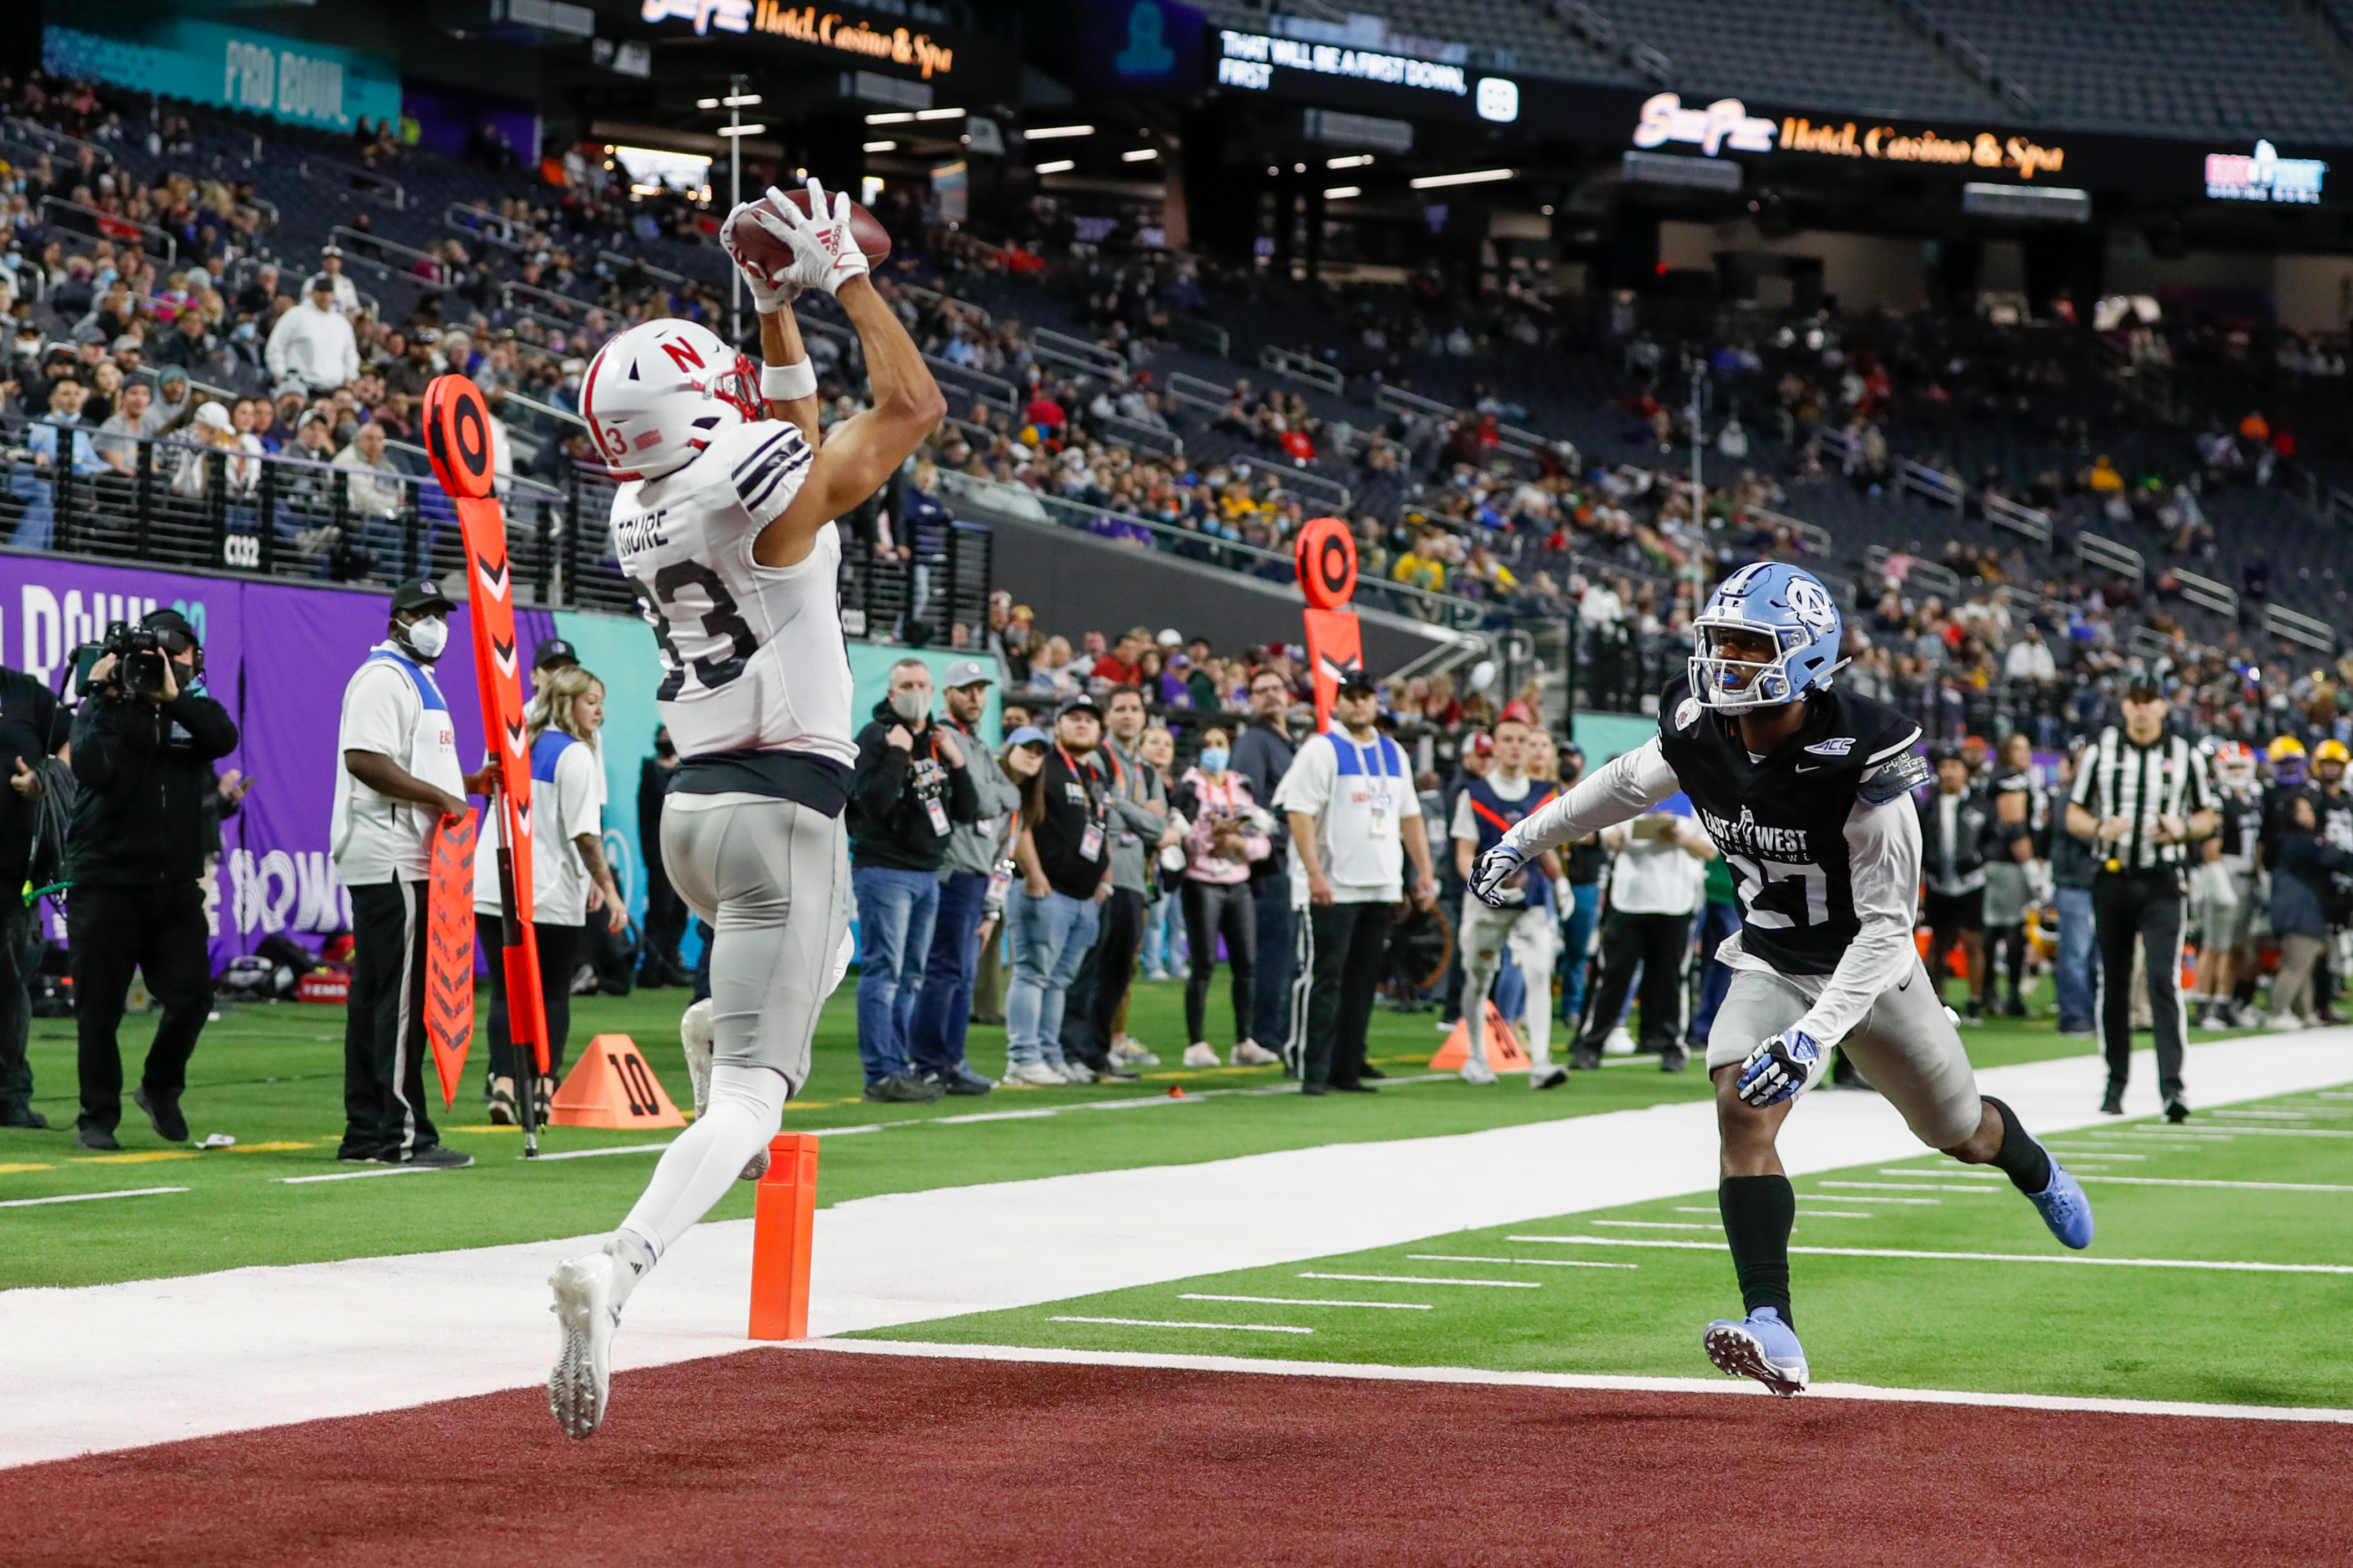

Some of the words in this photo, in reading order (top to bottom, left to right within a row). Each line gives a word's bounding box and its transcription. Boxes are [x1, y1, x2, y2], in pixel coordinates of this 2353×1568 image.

[819, 14, 892, 56] Casino
[892, 27, 912, 64] &
[912, 34, 952, 79] Spa
[1221, 31, 1271, 62] THAT
[1272, 39, 1313, 69] WILL
[1313, 45, 1341, 74] BE
[1341, 50, 1357, 77] A
[1357, 52, 1406, 83] FIRST
[224, 40, 276, 109] PRO
[1219, 58, 1274, 90] FIRST
[1865, 126, 1971, 165] Casino
[1972, 133, 2003, 168] &
[2004, 136, 2064, 179] Spa
[831, 224, 842, 256] adidas
[661, 336, 706, 374] N
[606, 428, 628, 455] 3
[619, 509, 669, 556] TOURE
[1812, 738, 1853, 751] ACC
[1702, 808, 1730, 841] EAST
[1755, 825, 1807, 852] WEST
[1719, 848, 1829, 929] 27
[608, 1054, 659, 1115] 10
